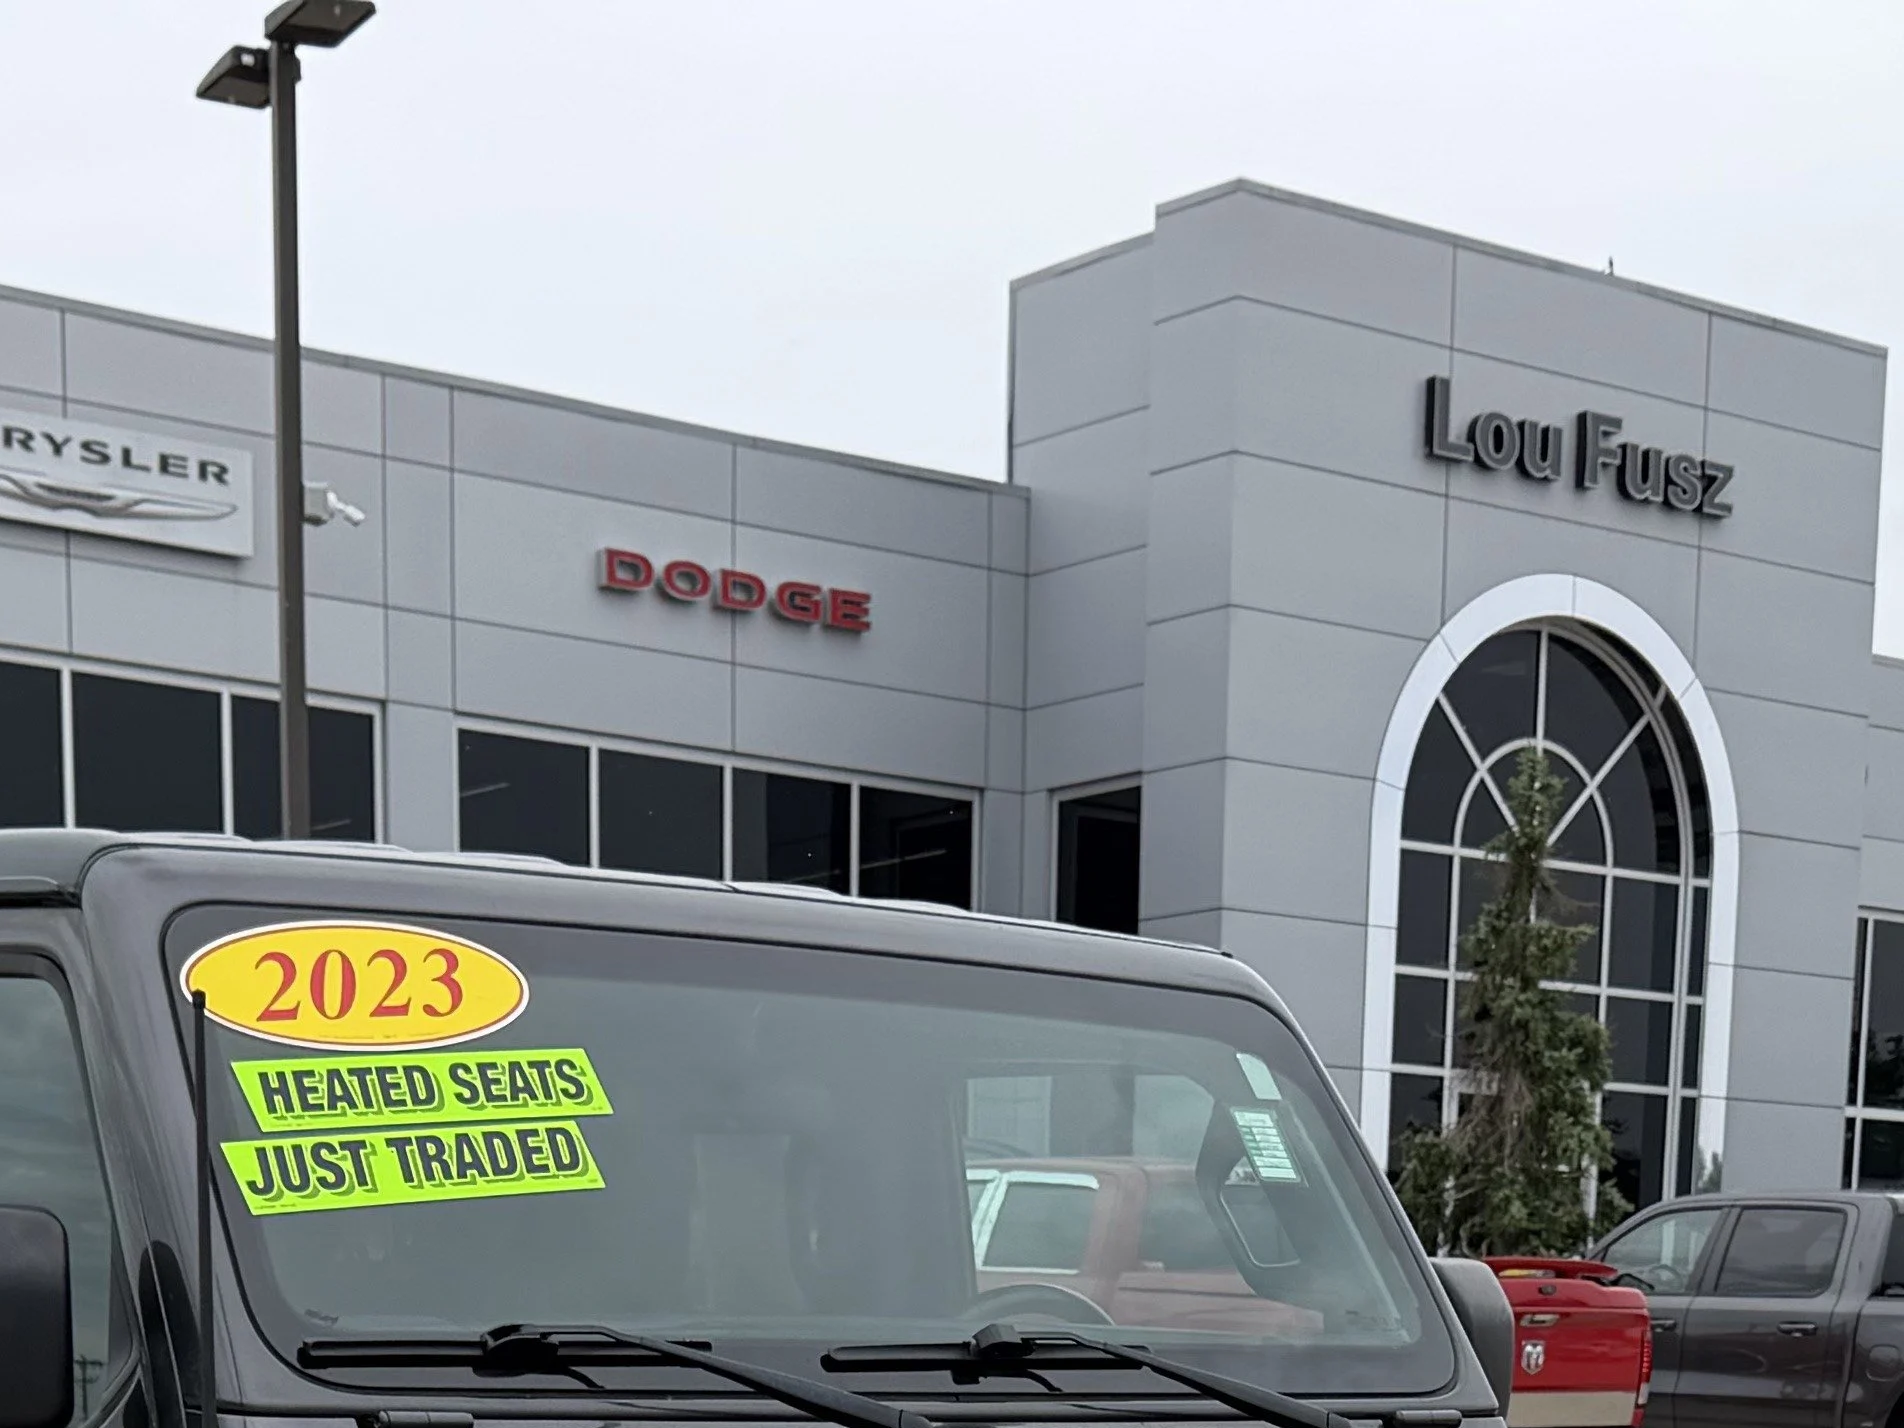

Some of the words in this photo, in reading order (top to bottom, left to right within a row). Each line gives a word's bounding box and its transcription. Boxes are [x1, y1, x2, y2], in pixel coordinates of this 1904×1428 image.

[1424, 375, 1563, 481] Lou
[1574, 410, 1734, 519] Fusz
[598, 546, 872, 632] DODGE
[254, 948, 464, 1022] 2023
[258, 1065, 443, 1119] HEATED
[452, 1058, 594, 1111] SEATS
[246, 1140, 380, 1201] JUST
[386, 1127, 590, 1189] TRADED
